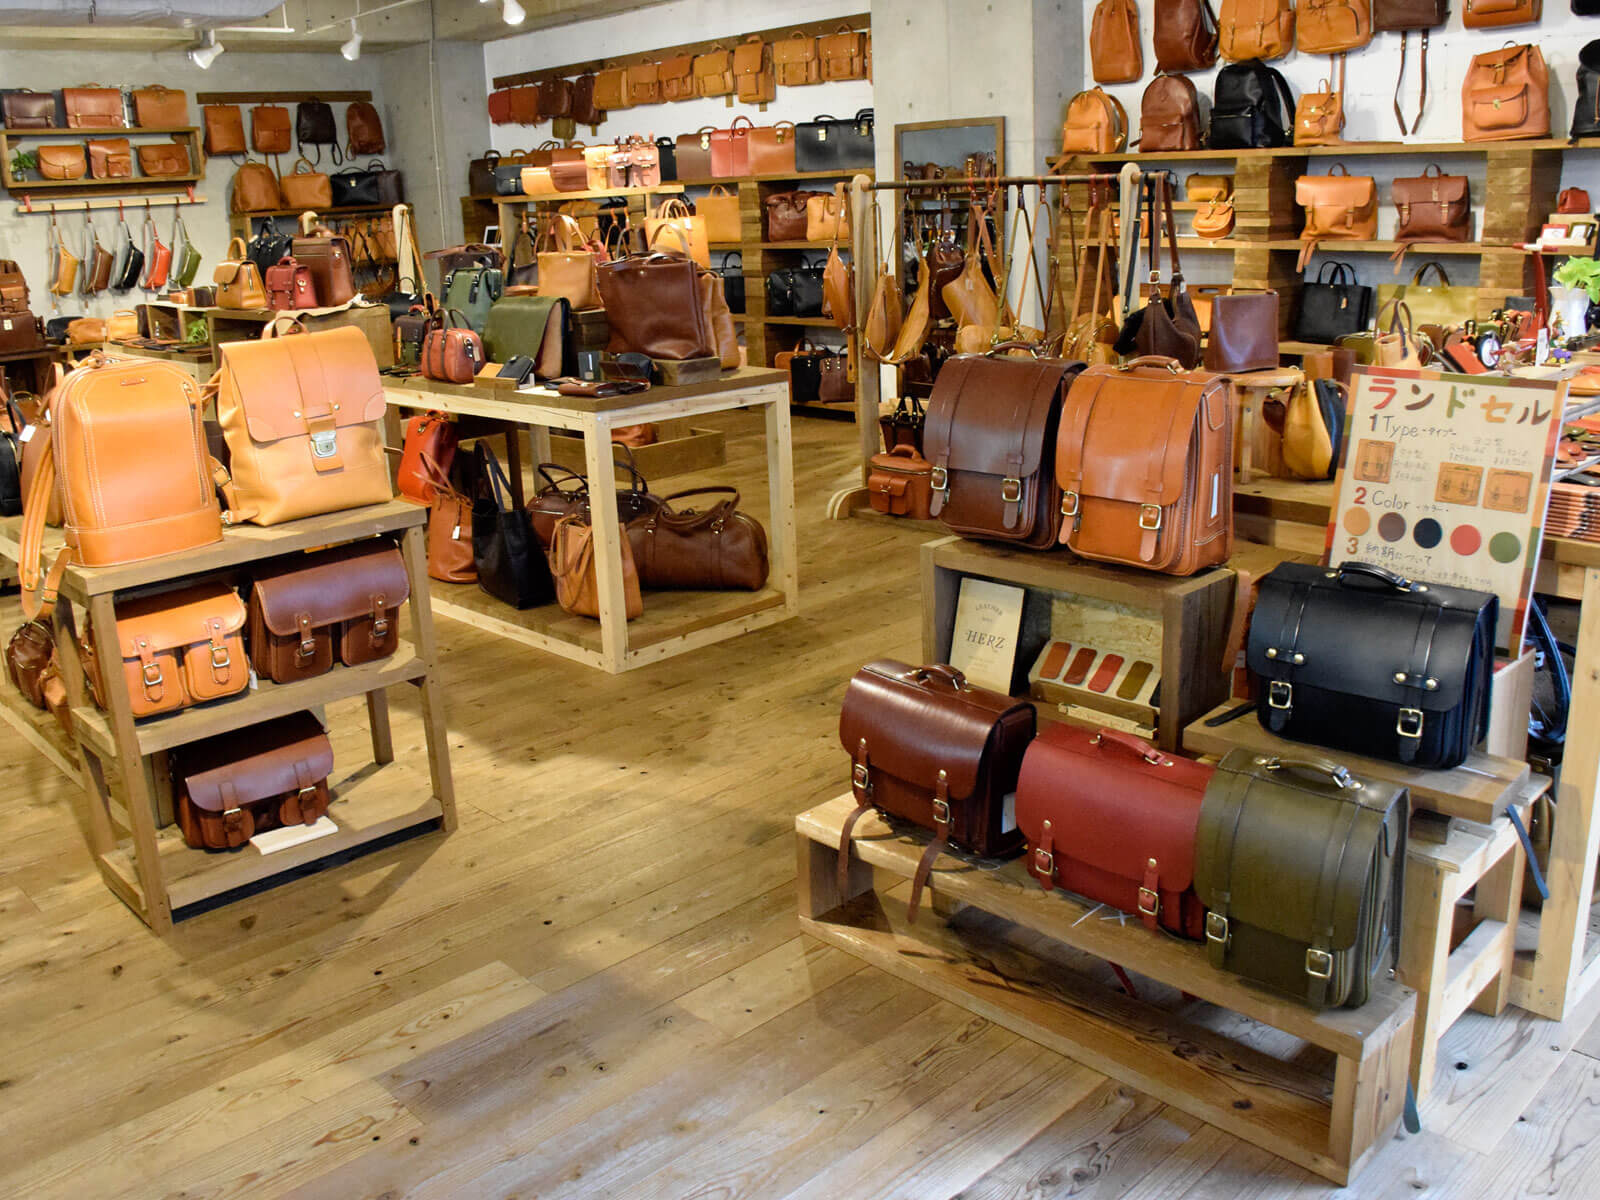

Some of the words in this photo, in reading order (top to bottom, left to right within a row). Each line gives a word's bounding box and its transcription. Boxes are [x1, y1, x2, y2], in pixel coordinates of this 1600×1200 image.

[1368, 378, 1552, 426] ランドセル
[1369, 414, 1378, 432] 1
[1383, 415, 1419, 440] Type
[1353, 486, 1367, 505] 2
[1372, 490, 1410, 510] Color
[1346, 537, 1359, 555] 3
[966, 629, 1006, 649] HERZ
